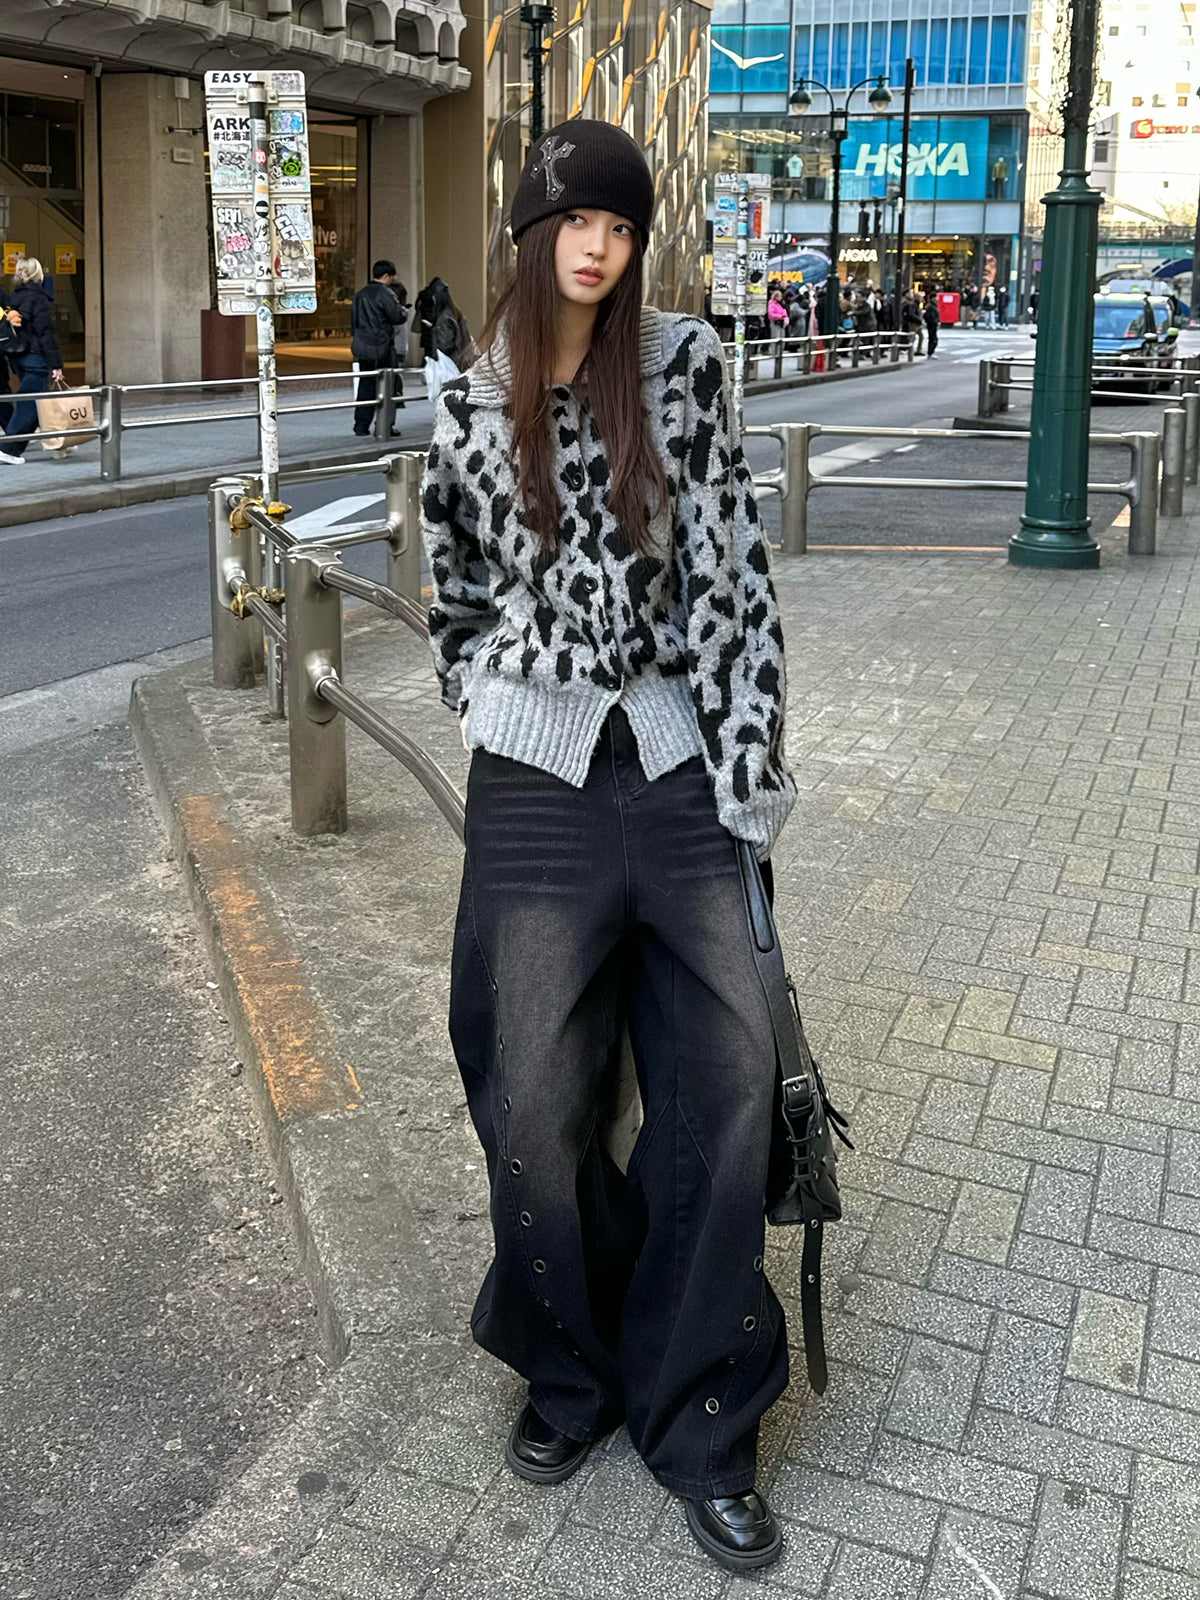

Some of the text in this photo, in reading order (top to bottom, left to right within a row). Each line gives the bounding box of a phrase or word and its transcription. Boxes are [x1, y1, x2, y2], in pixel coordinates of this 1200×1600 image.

[212, 73, 252, 83] EASY
[213, 118, 250, 130] ARK
[854, 142, 970, 177] HOKA
[838, 248, 878, 262] HOKA
[69, 407, 87, 420] GU
